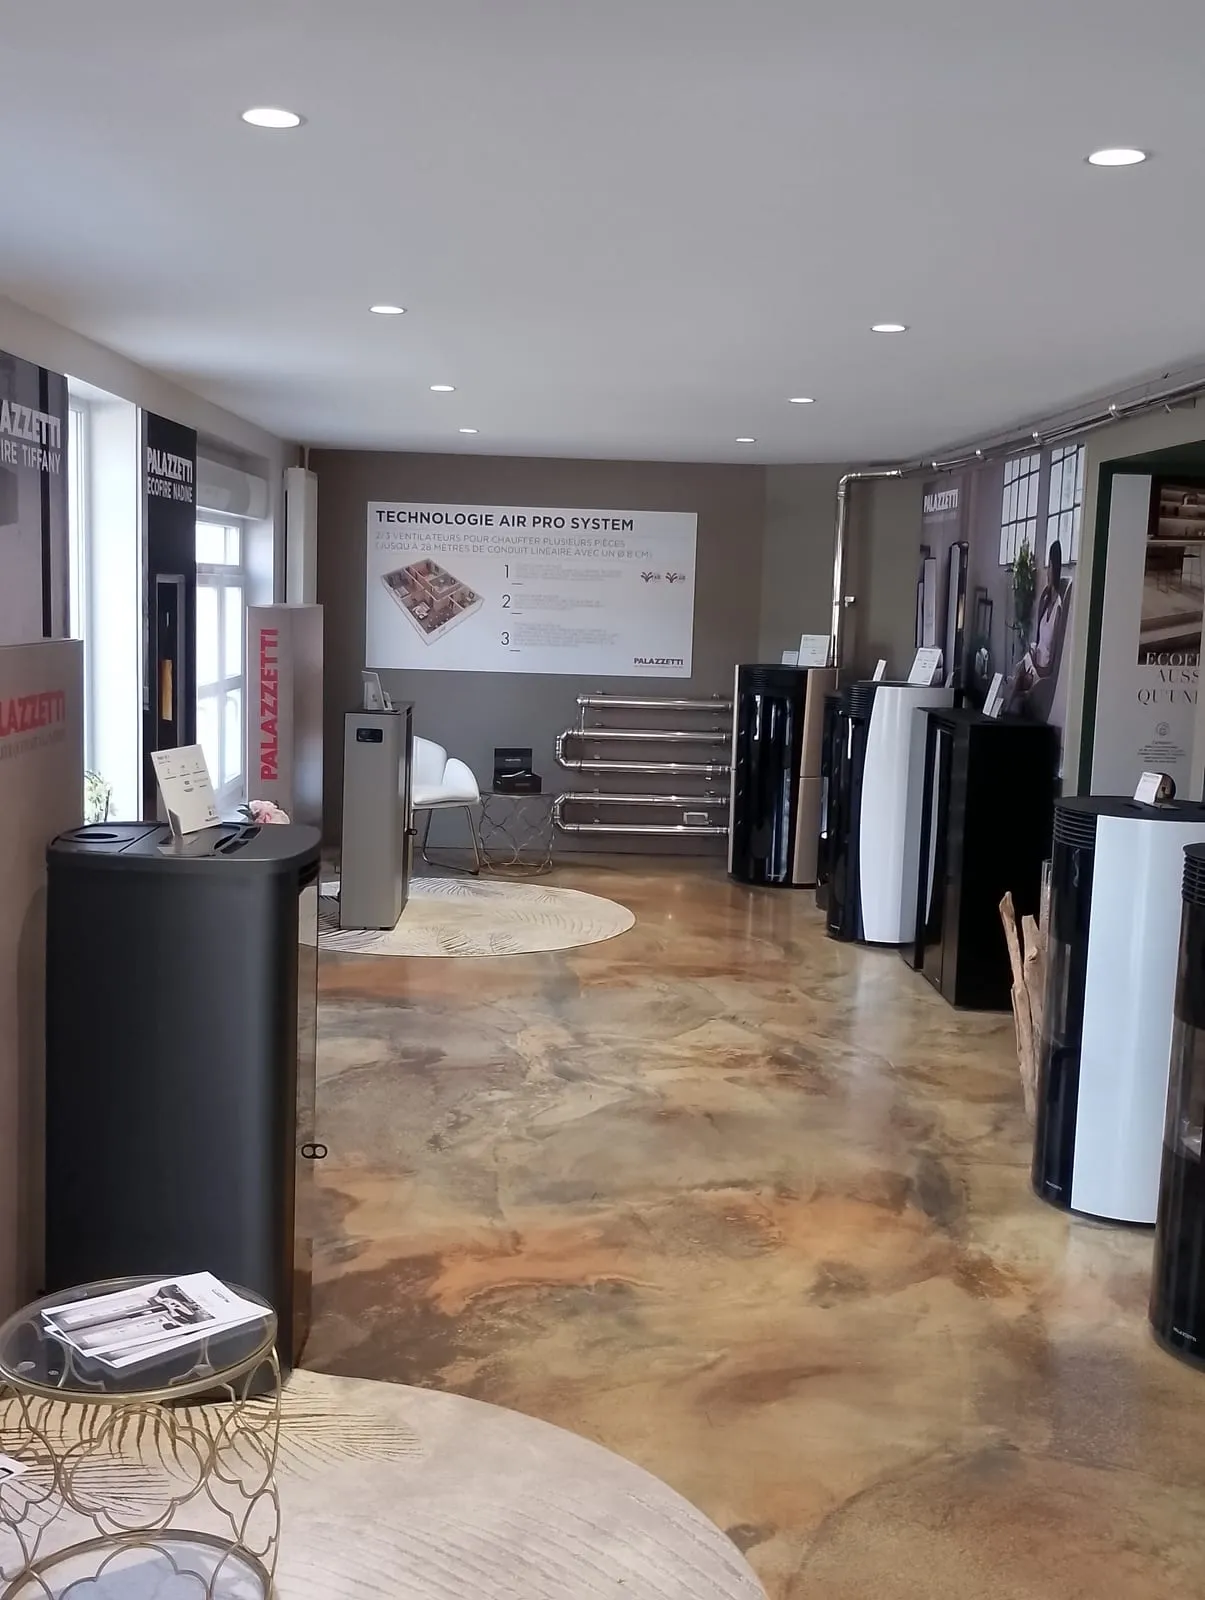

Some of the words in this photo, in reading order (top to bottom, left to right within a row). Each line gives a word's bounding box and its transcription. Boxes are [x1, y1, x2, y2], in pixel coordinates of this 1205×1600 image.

[21, 443, 61, 475] TIFFANY
[147, 446, 193, 484] PALAZZETTI
[148, 476, 172, 499] ECOFIRE
[923, 488, 959, 512] PALAZZETTI
[375, 510, 495, 527] TECHNOLOGIE
[499, 514, 527, 528] AIR
[532, 516, 566, 529] PRO
[570, 517, 635, 532] SYSTEM
[393, 532, 461, 542] VENTILATEURS
[463, 535, 489, 544] POUR
[490, 536, 541, 545] CHAUFFER
[543, 538, 593, 548] PLUSIEURS
[420, 543, 432, 551] 28
[472, 545, 485, 553] DE
[487, 545, 528, 555] CONDUIT
[575, 548, 600, 558] AVEC
[601, 549, 616, 558] UN
[504, 564, 510, 579] 1
[502, 594, 511, 609] 2
[500, 631, 510, 646] 3
[633, 657, 684, 665] PALAZZETTI
[259, 628, 279, 781] PALAZZETTI
